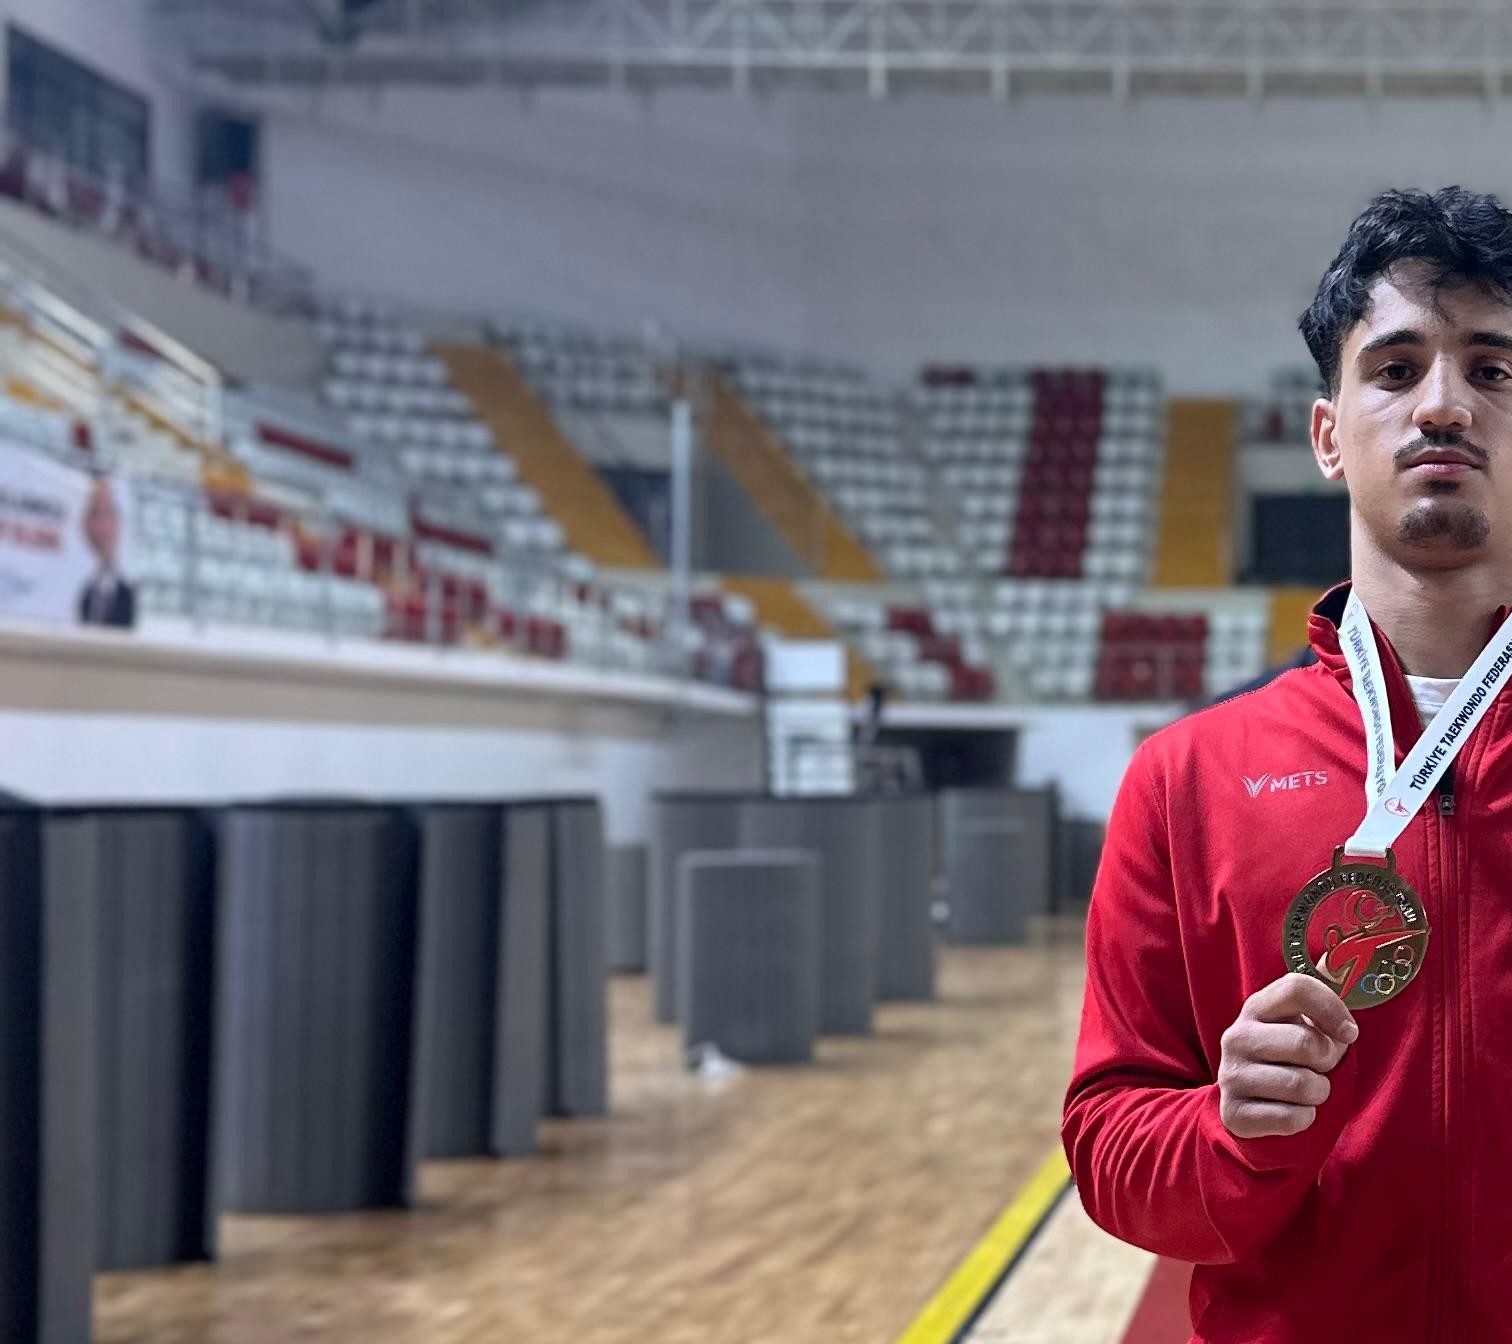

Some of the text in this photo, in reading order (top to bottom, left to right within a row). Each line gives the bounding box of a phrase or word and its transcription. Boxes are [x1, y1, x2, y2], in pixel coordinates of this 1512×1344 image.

[1409, 744, 1447, 792] TÜRKİYE
[1439, 686, 1487, 748] TAEKWONDO
[1269, 769, 1328, 793] METS
